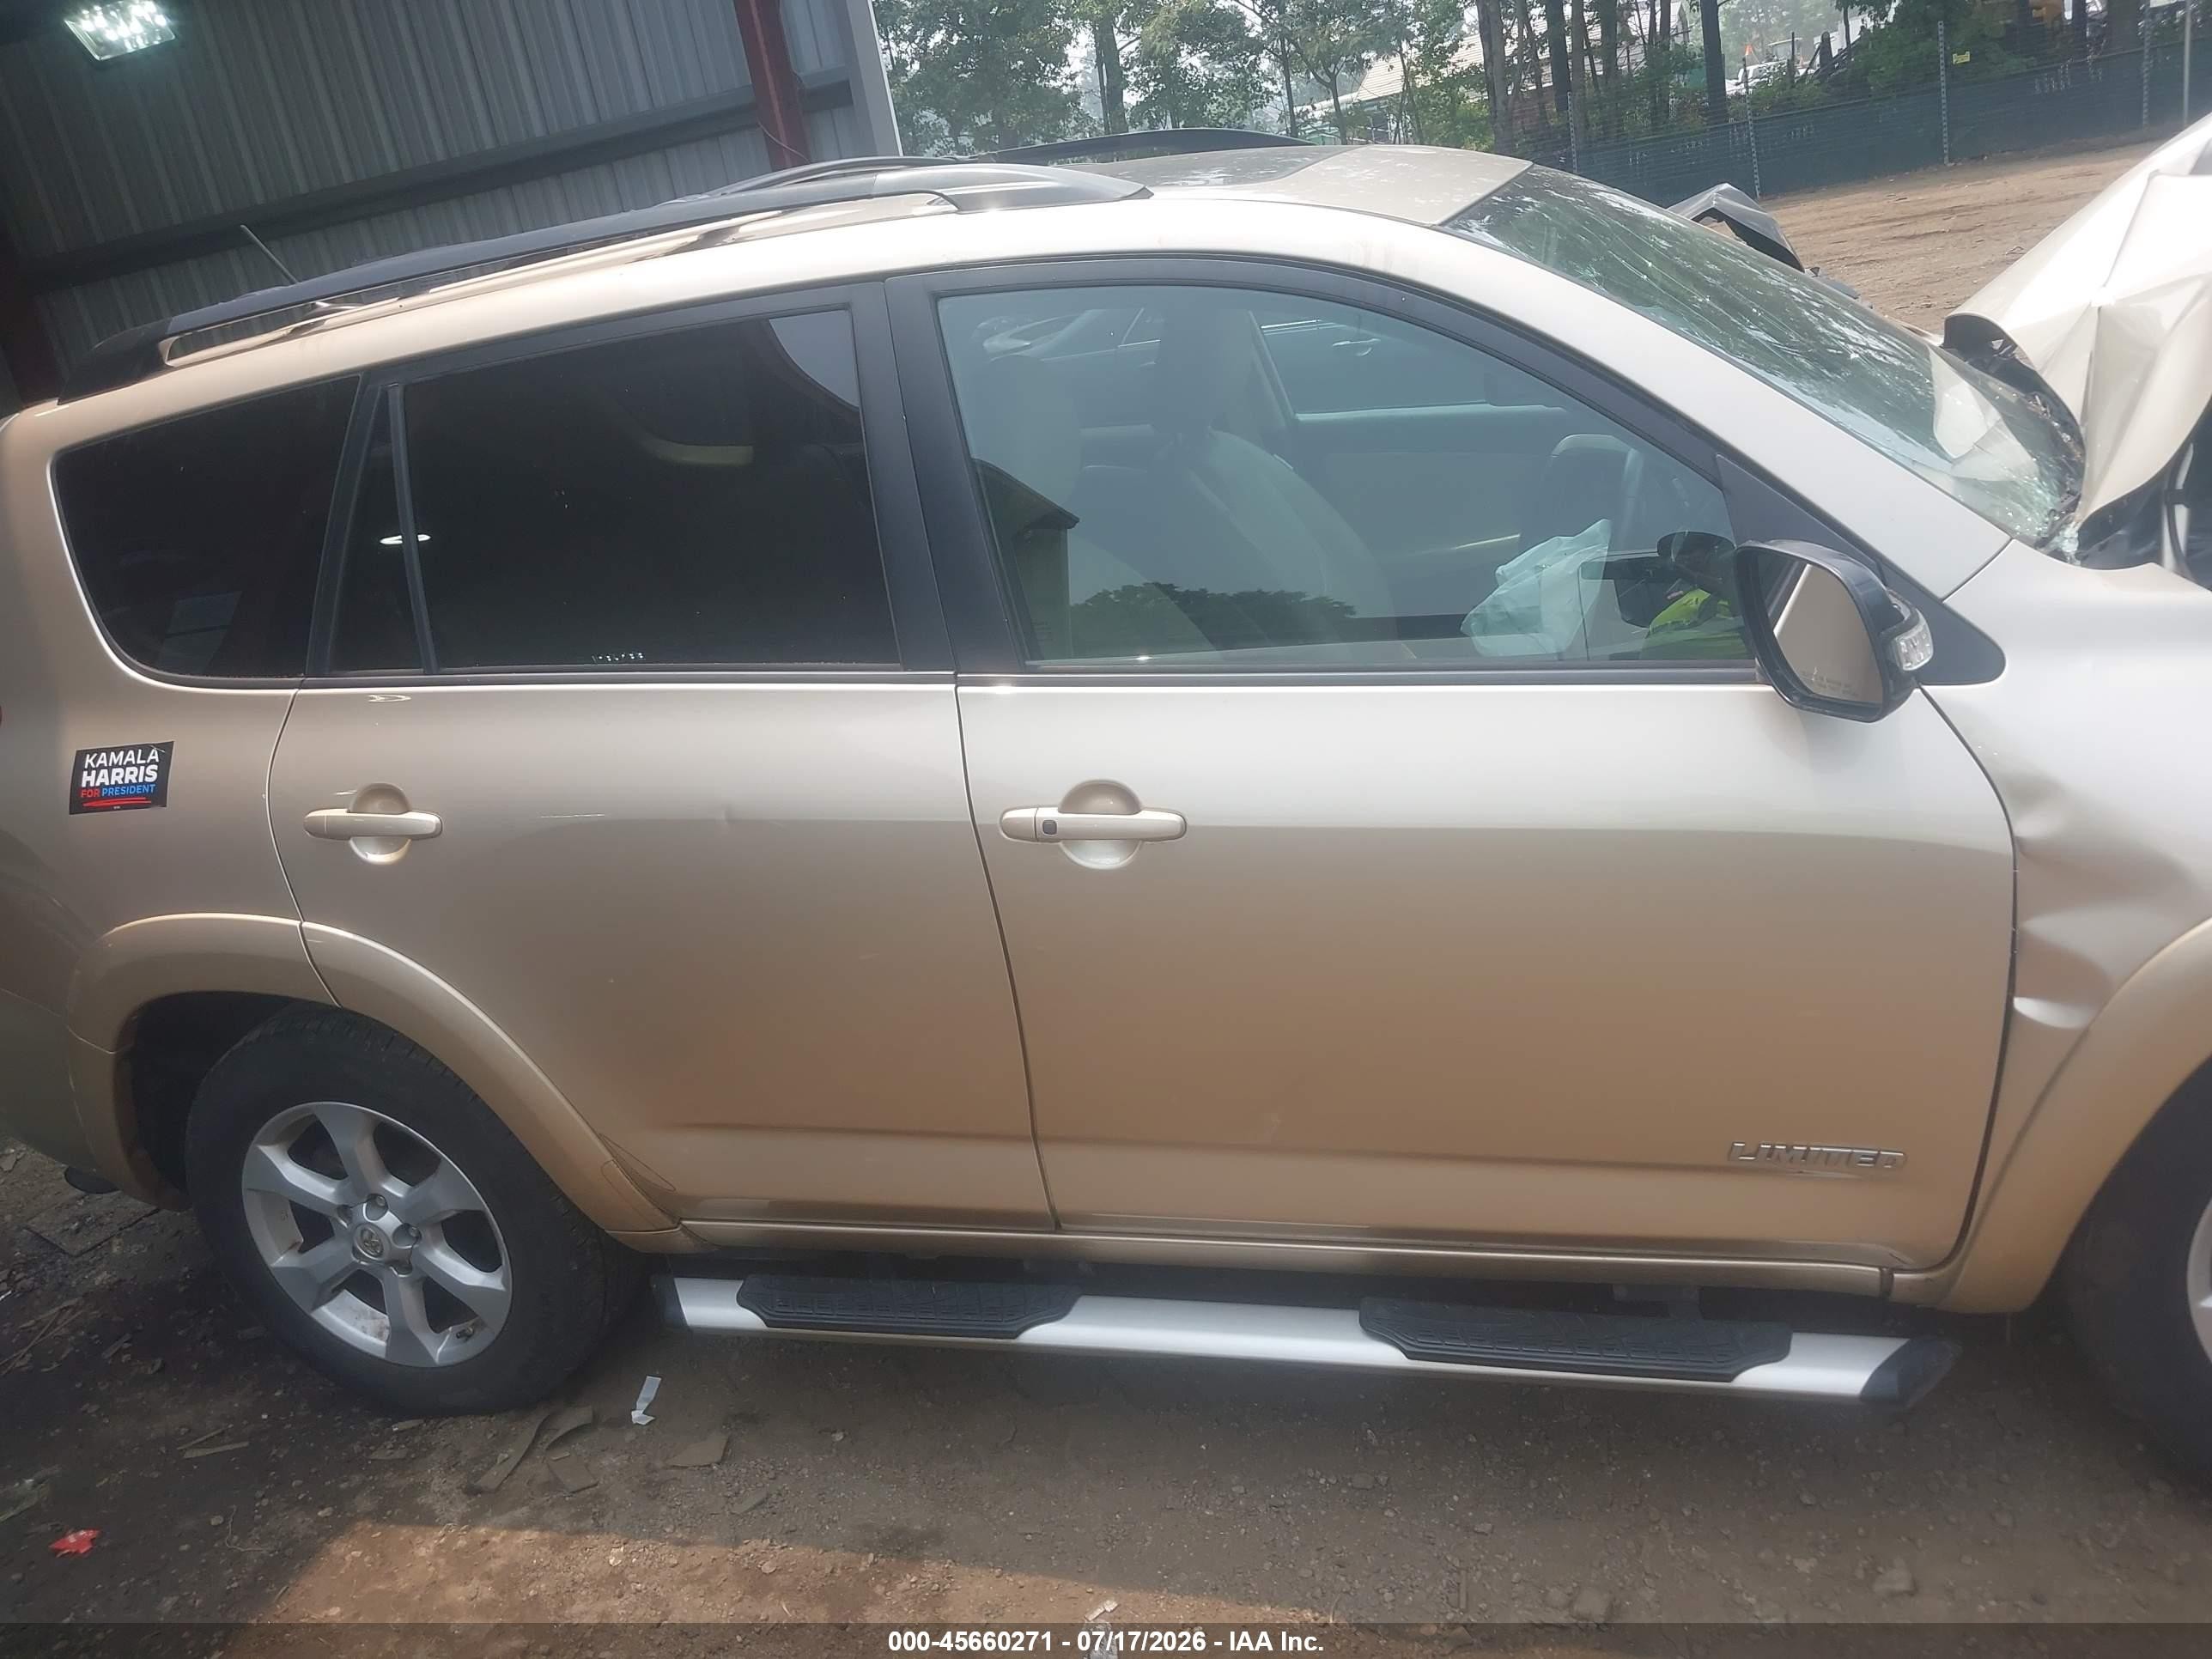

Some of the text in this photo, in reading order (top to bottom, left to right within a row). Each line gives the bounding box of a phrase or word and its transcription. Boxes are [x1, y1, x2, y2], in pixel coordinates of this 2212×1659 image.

[84, 748, 160, 769] KAMALA
[82, 764, 158, 787] HARRIS
[81, 783, 156, 799] FOR PRESIDENT
[1729, 1141, 1906, 1170] LIMITED
